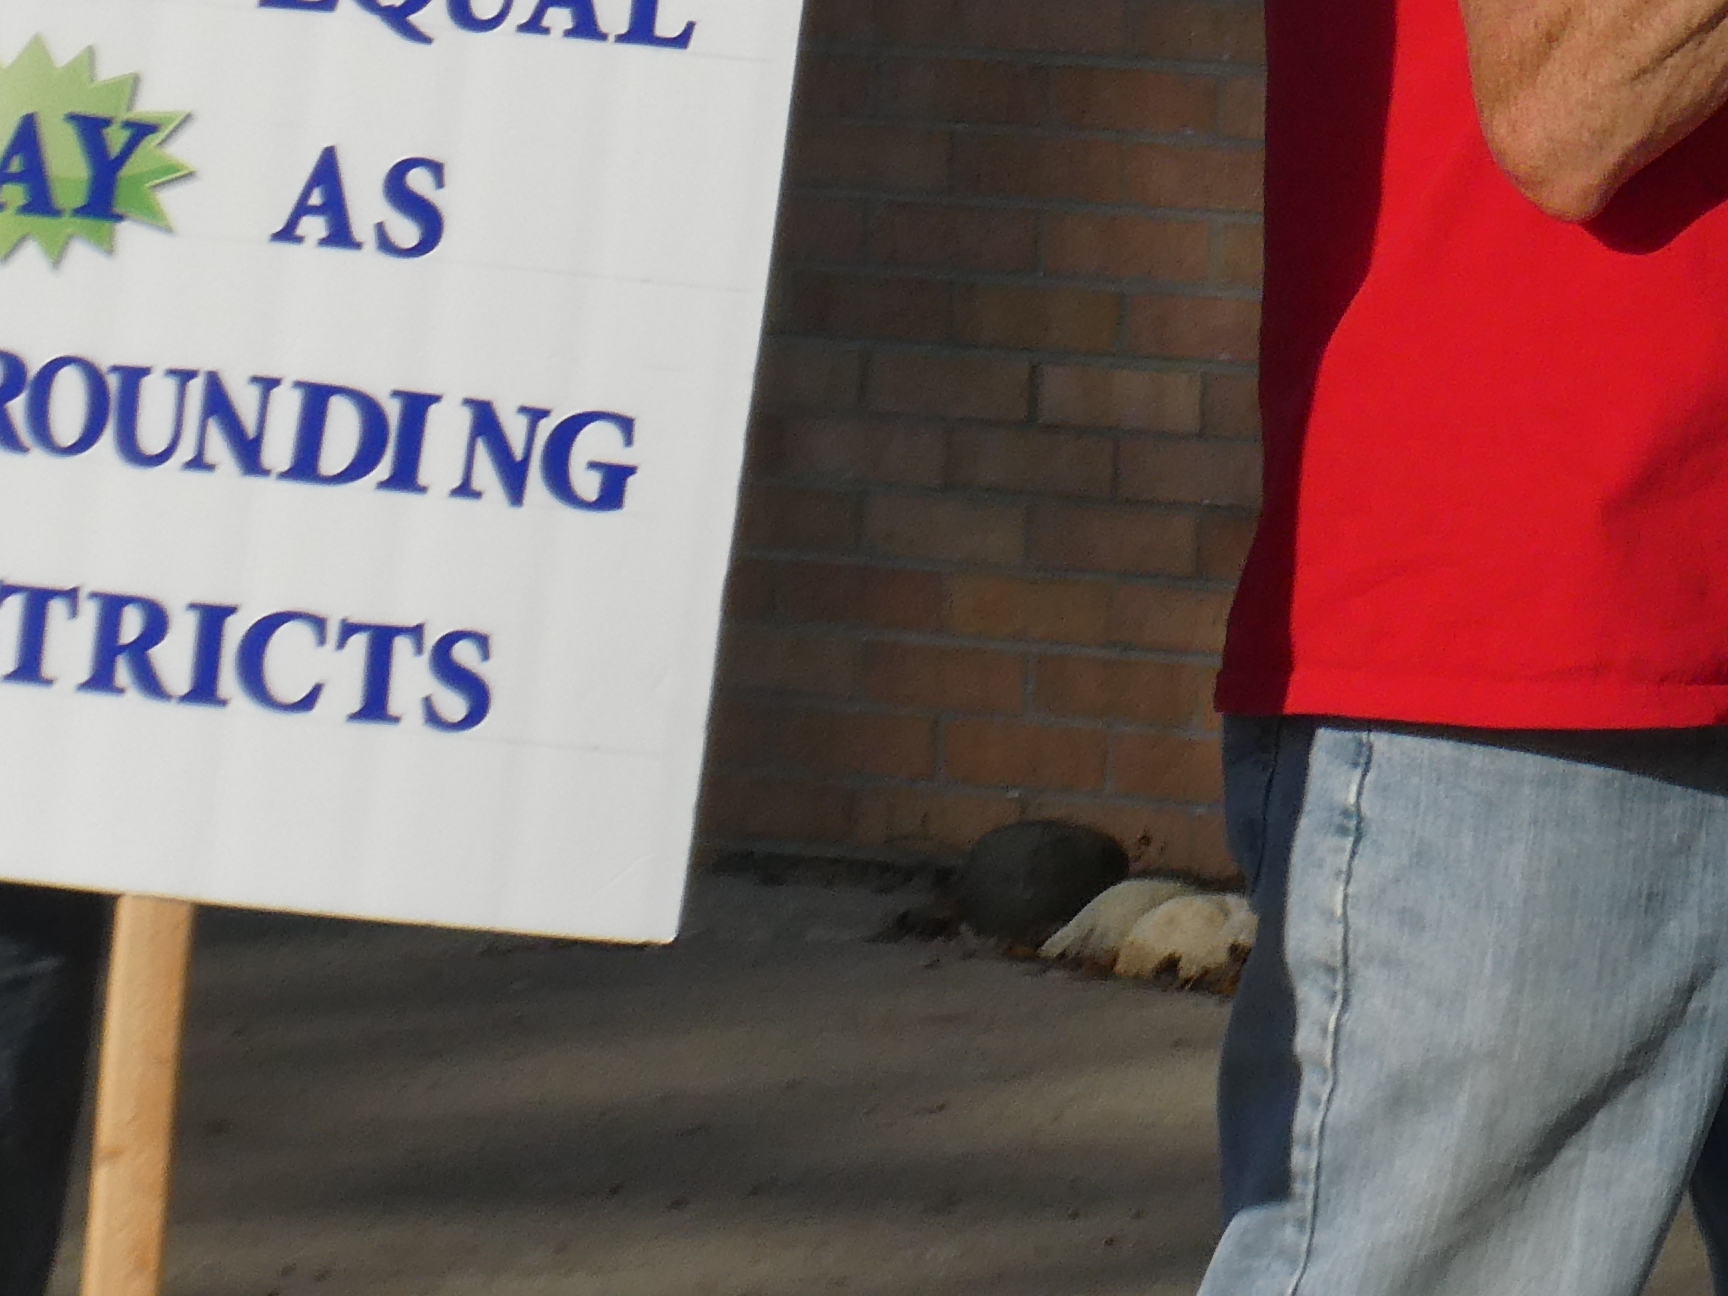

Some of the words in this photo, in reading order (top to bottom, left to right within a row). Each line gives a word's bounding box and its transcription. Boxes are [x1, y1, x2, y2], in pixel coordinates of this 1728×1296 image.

[0, 111, 160, 222] AY
[271, 145, 447, 260] AS
[0, 582, 495, 733] TRICTS
